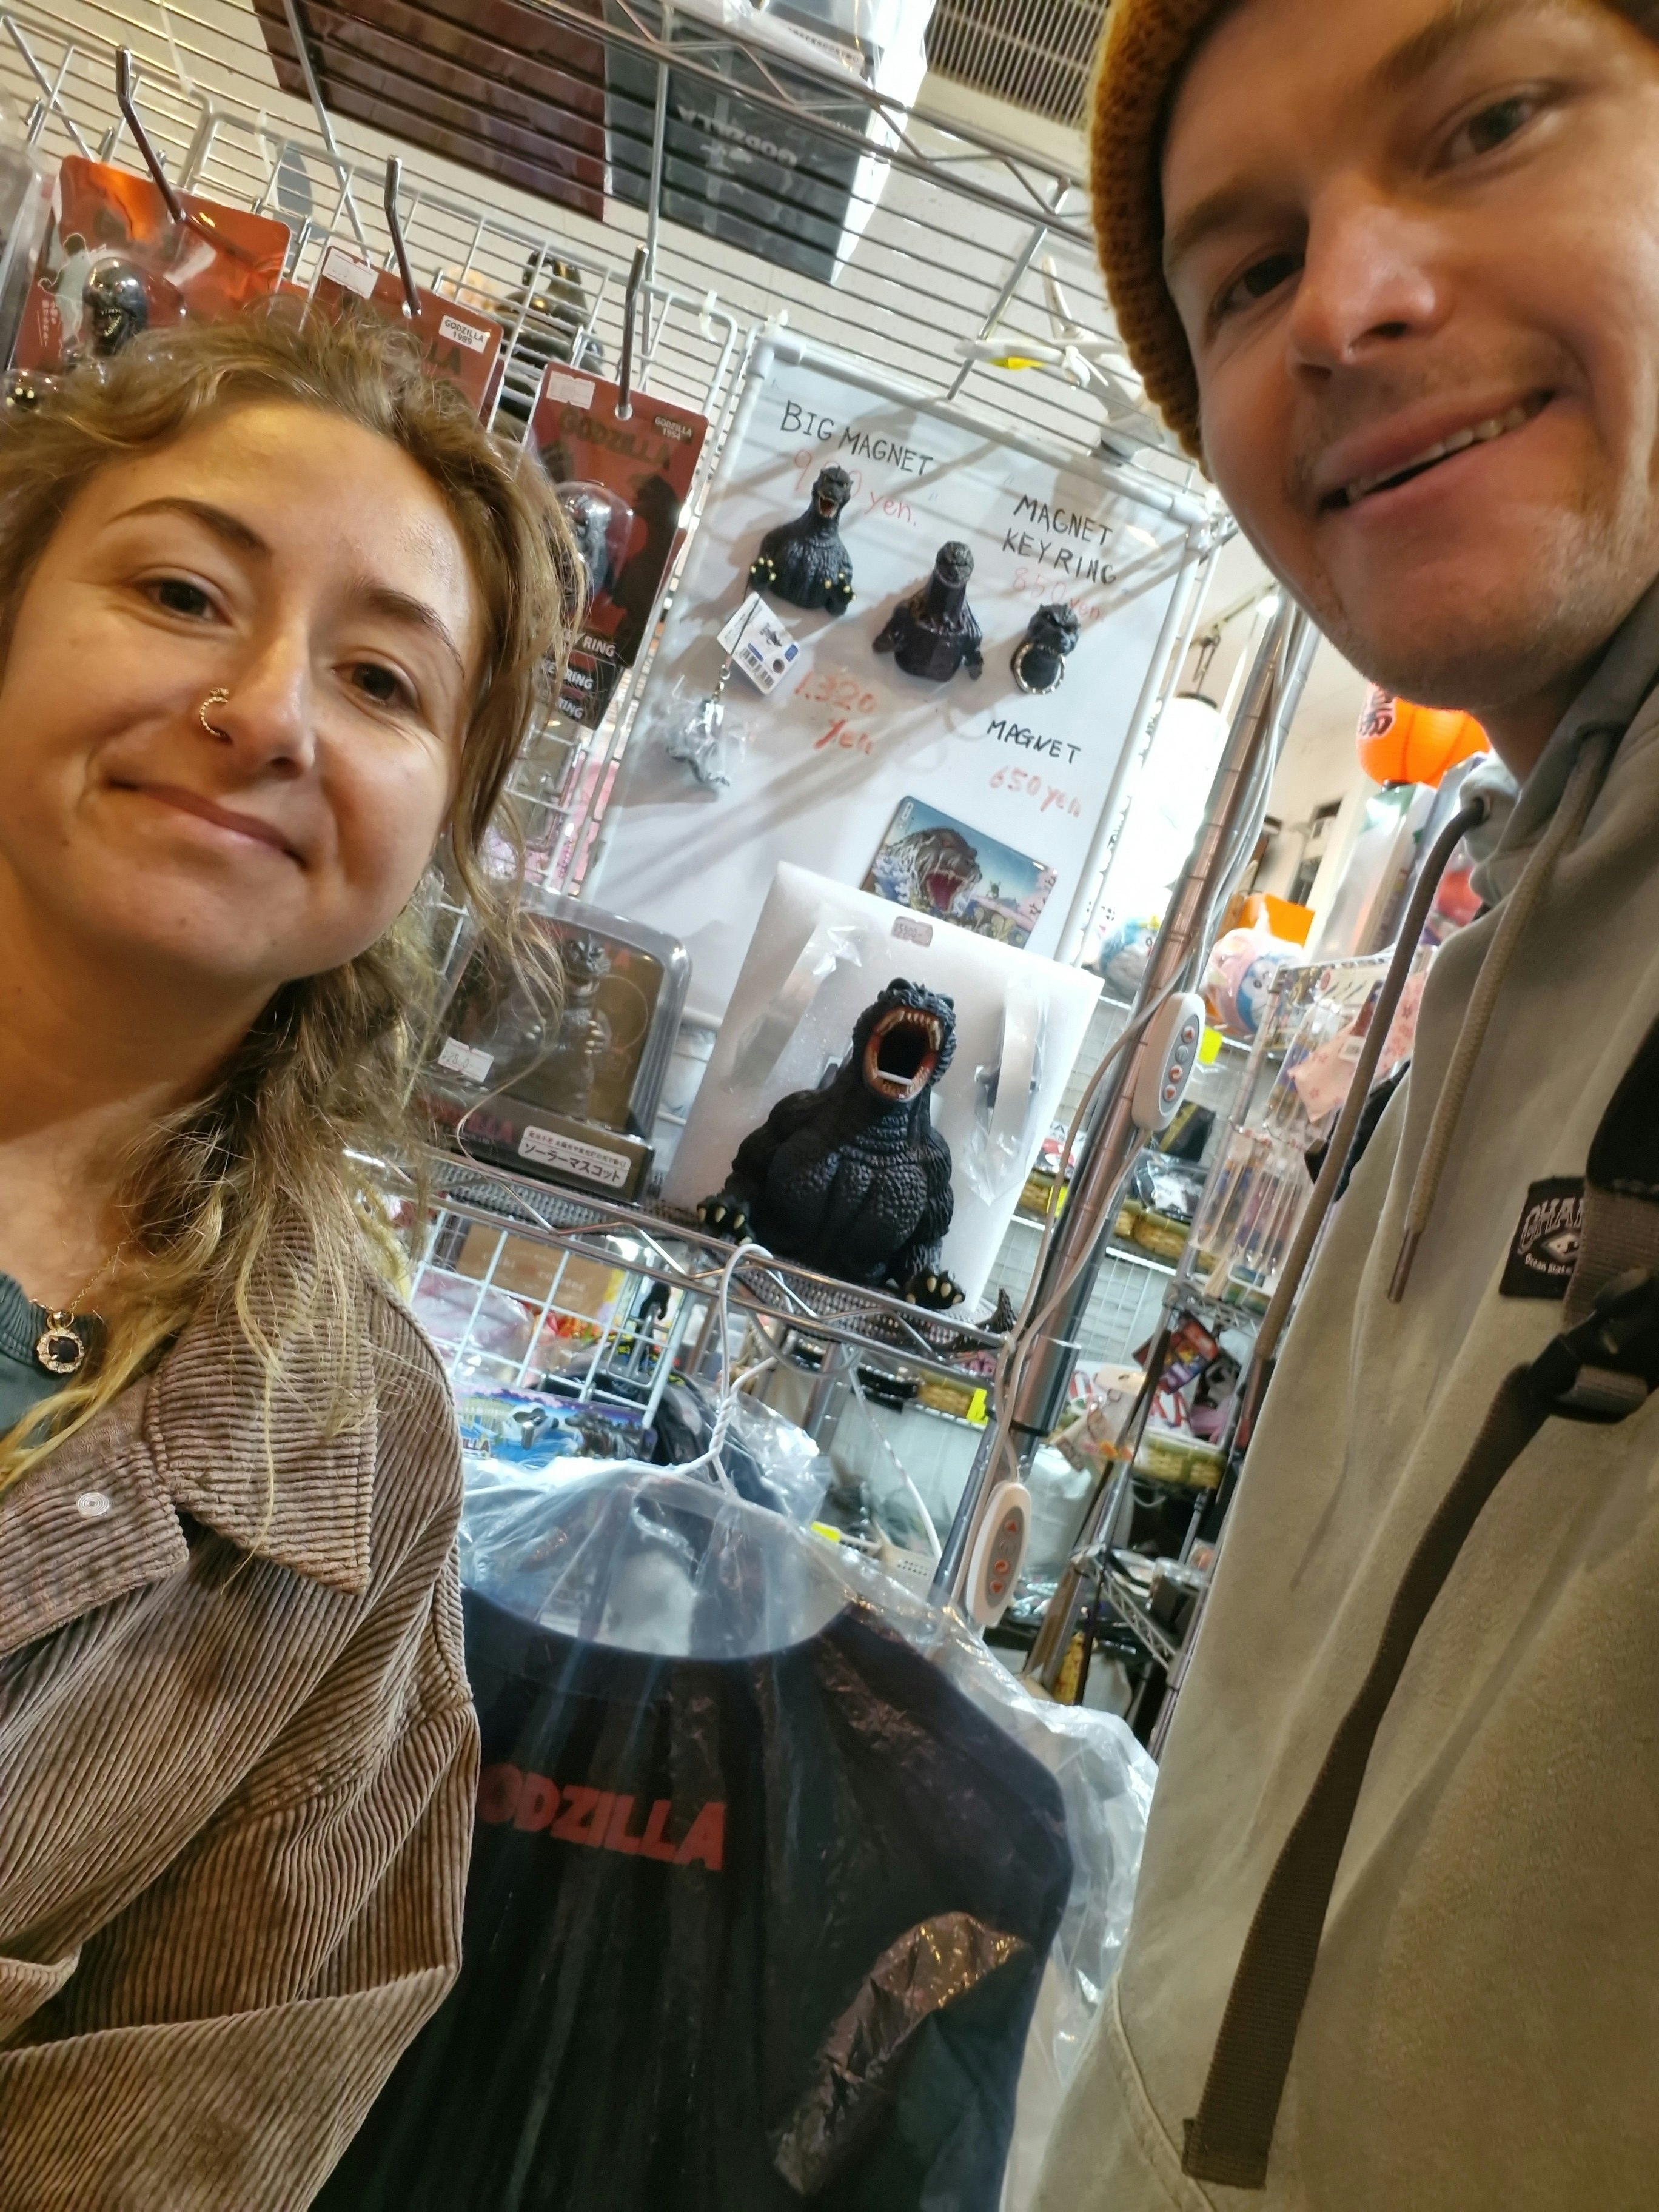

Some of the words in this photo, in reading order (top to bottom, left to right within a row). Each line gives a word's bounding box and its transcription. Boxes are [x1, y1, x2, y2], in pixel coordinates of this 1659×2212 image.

[444, 320, 483, 343] GODZILLA
[453, 331, 472, 345] 1989
[655, 417, 692, 437] GODZILLA
[663, 427, 680, 441] 1954
[781, 400, 834, 441] BIG
[838, 426, 933, 475] MAGNET
[1013, 494, 1113, 545] MAGNET
[1013, 567, 1066, 605] 850
[582, 635, 617, 657] RING
[565, 668, 594, 690] RING
[987, 720, 1081, 764] MAGNET
[989, 766, 1042, 796] 650
[1040, 786, 1081, 818] yen
[525, 1142, 620, 1182] ソーラーマスコット
[478, 1763, 725, 1871] ODZILLA
